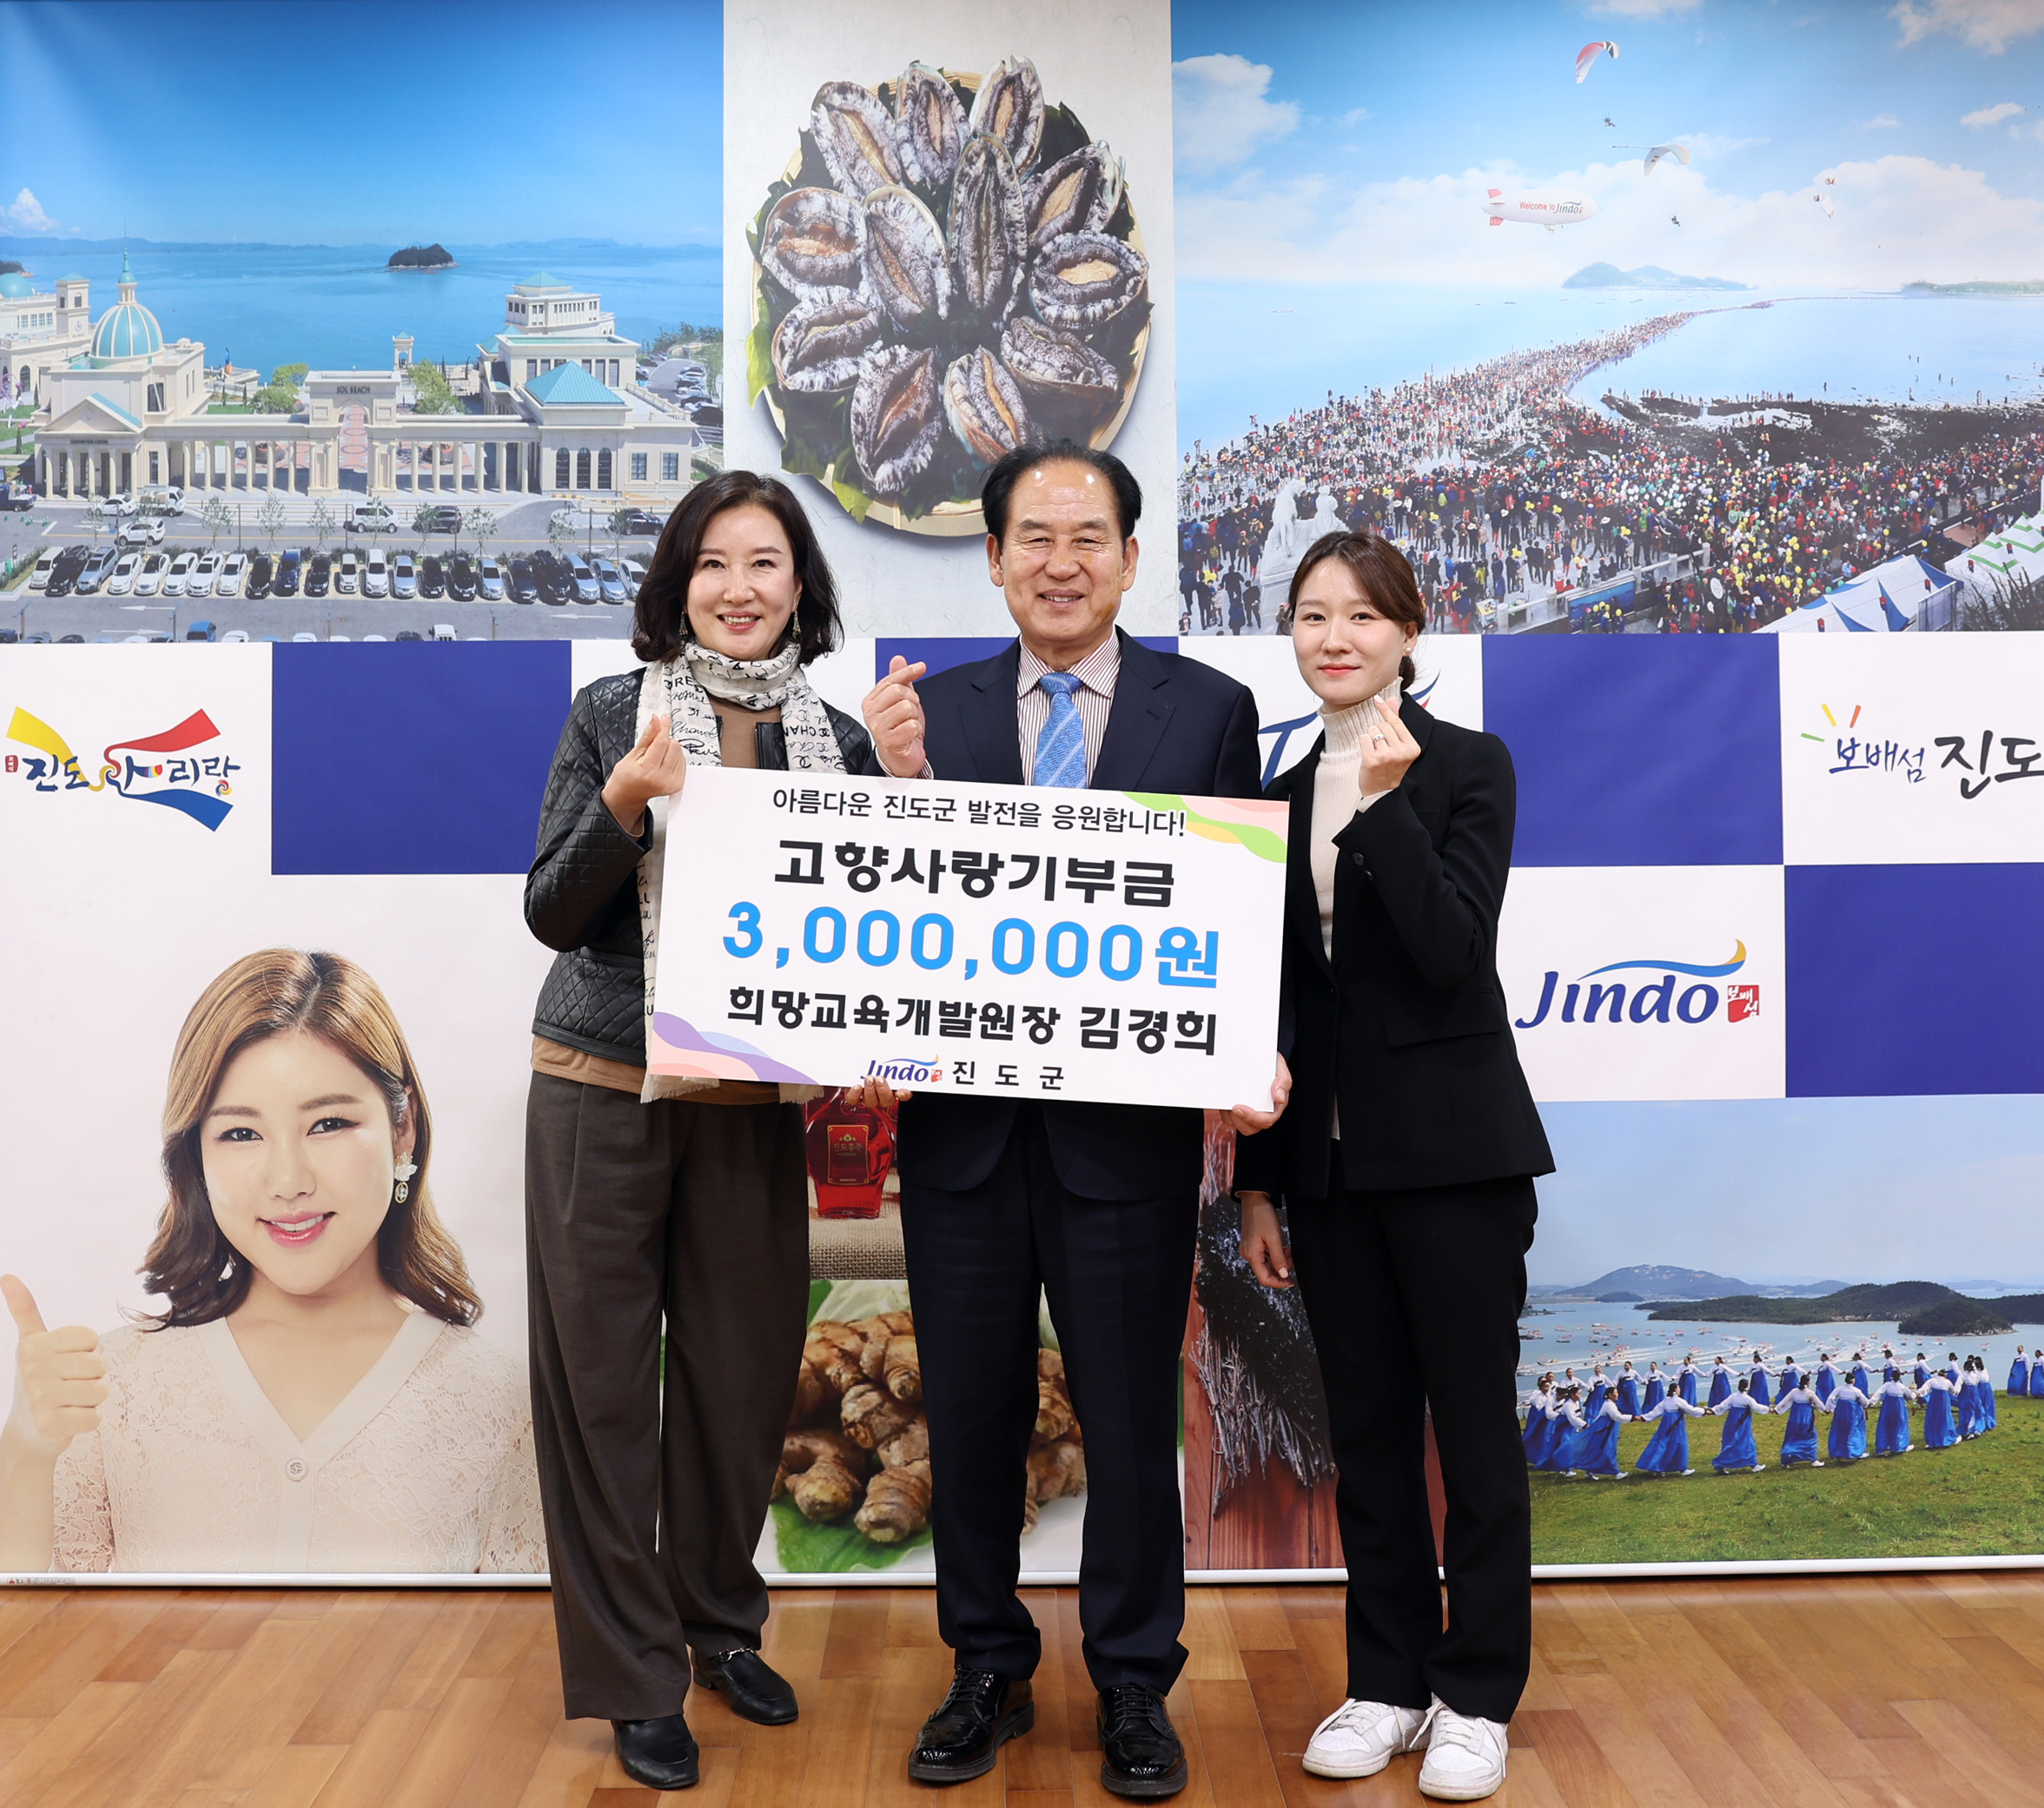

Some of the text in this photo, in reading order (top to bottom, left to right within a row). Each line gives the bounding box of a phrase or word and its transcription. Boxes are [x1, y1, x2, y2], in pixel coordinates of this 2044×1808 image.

[1519, 201, 1548, 211] Welcome
[1829, 729, 2044, 799] 보배섬 진도
[772, 788, 1186, 837] 아름다운 진도군 발전을 응원합니다!
[774, 839, 1174, 908] 고향사랑기부금
[723, 901, 1219, 989] 3,000,000원
[727, 986, 1216, 1056] 희망교육개발원장 김경희
[1514, 970, 1719, 1029] Jindo
[860, 1059, 929, 1083] Jindo
